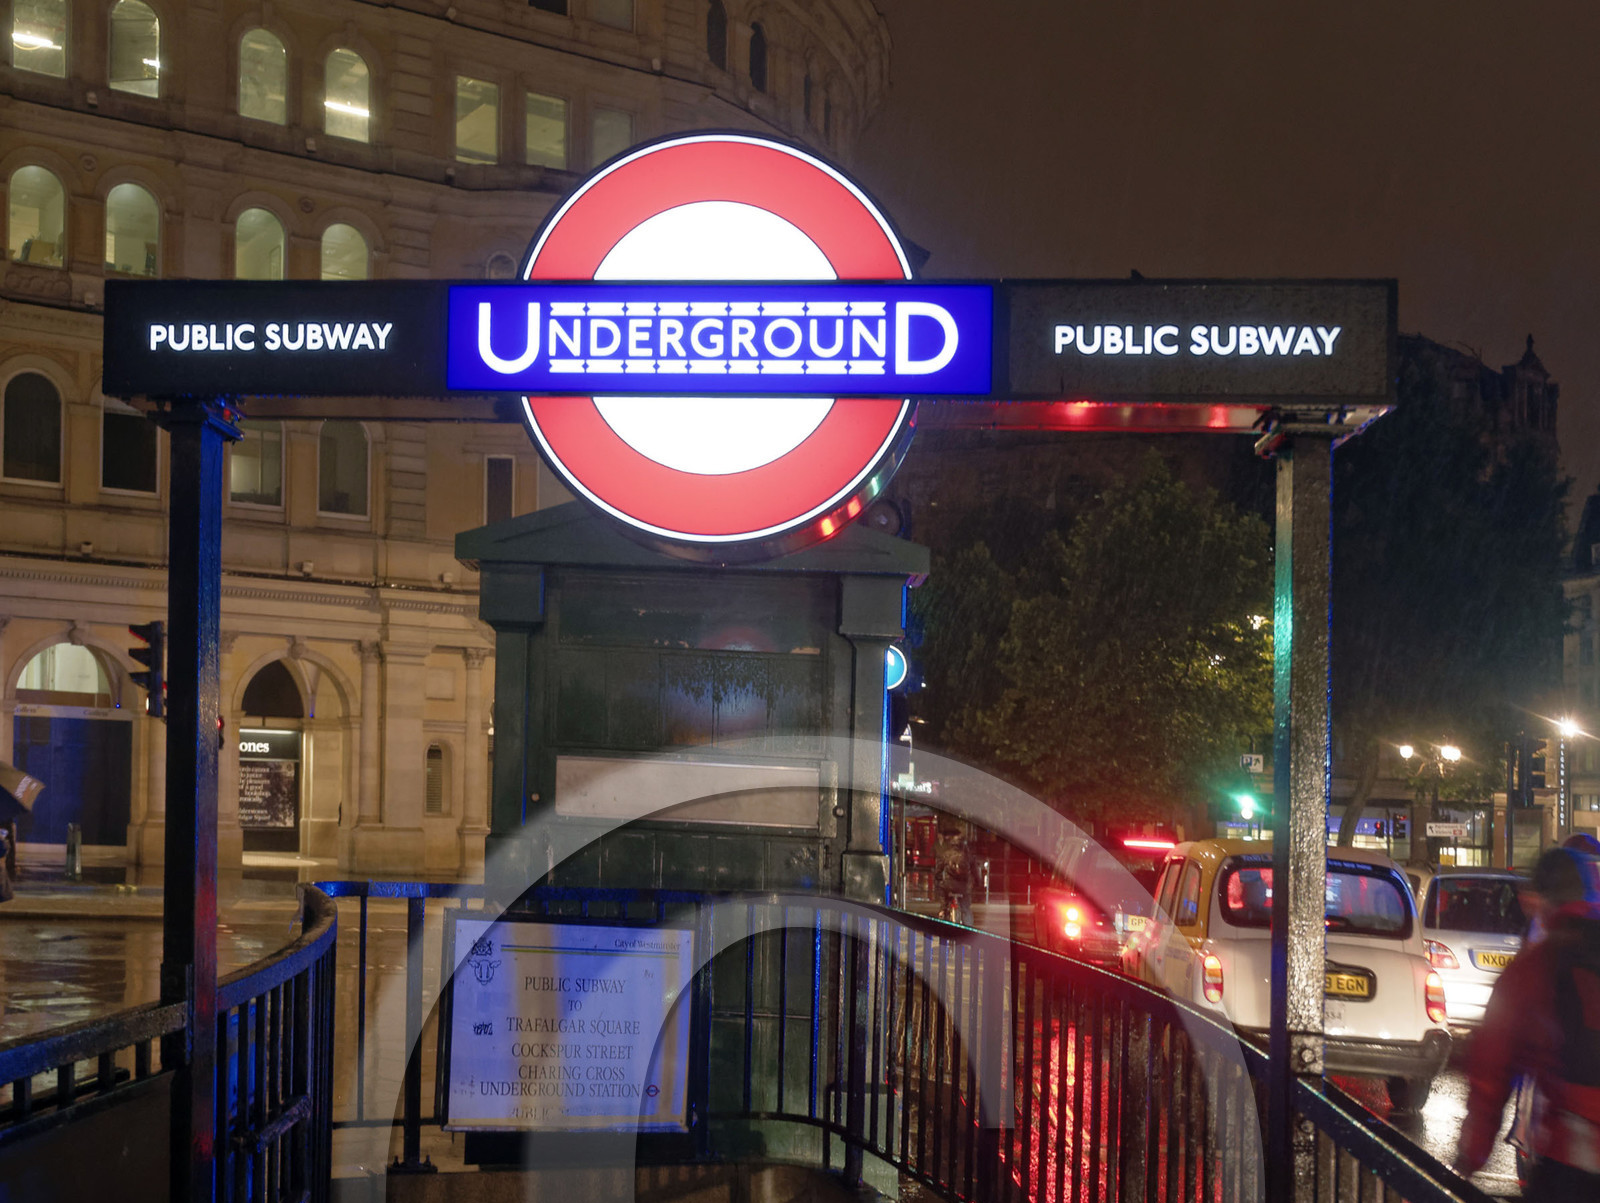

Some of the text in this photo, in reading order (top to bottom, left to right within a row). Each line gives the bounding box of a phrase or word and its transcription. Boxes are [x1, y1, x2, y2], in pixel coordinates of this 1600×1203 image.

[150, 322, 393, 351] PUBLIC SUBWAY
[478, 301, 959, 375] UNDERGROUND
[1054, 325, 1341, 356] PUBLIC SUBWAY
[239, 741, 270, 753] ones
[524, 976, 627, 994] PUBLIC SUBWAY
[1336, 977, 1366, 992] EGN
[568, 1000, 583, 1012] TO
[506, 1016, 586, 1034] TRAFALGAR
[589, 1019, 641, 1035] SQUARE
[511, 1042, 634, 1060] COCKSPUR STREET
[518, 1065, 626, 1081] CHARING CROSS
[480, 1081, 585, 1097] UNDERGROUND
[588, 1083, 641, 1098] STATION
